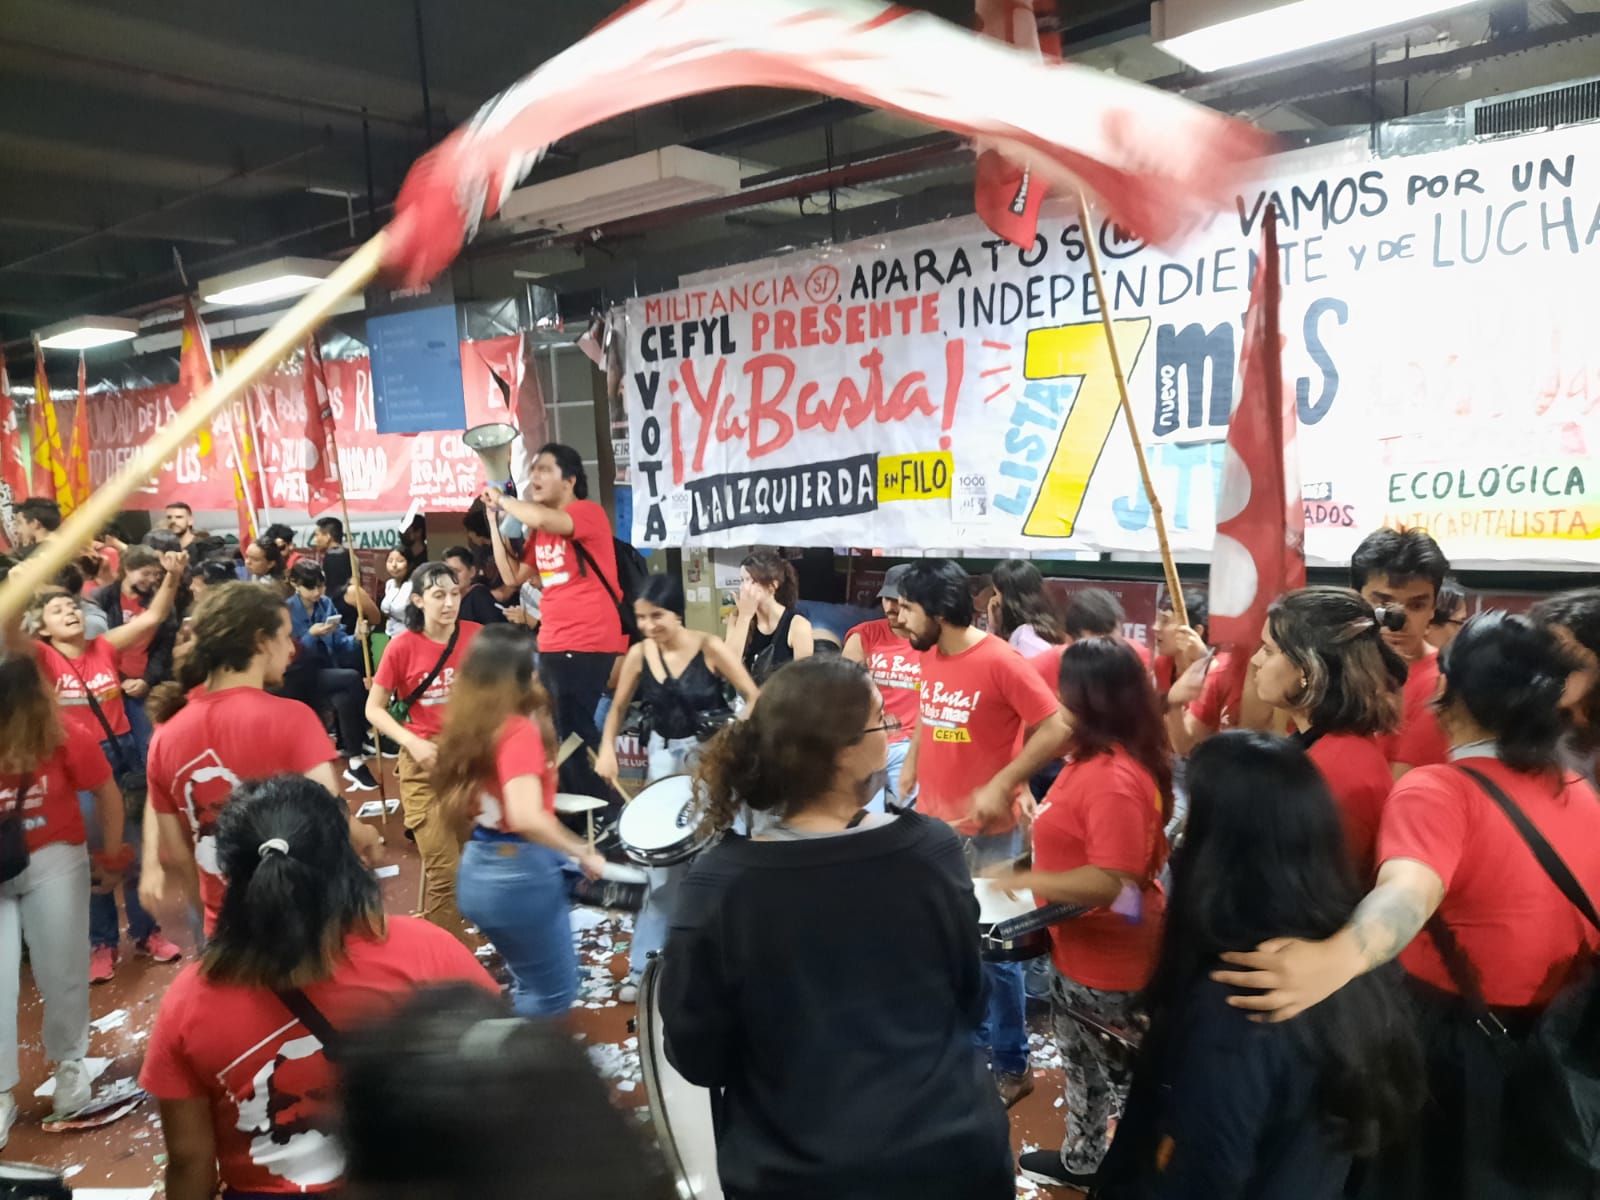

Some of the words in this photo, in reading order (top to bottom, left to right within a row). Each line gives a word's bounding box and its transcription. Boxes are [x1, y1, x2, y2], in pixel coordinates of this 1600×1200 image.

[645, 275, 799, 324] MILITANCIA
[850, 224, 1086, 300] APARATOS
[1235, 171, 1389, 236] VAMOS
[1407, 169, 1485, 206] POR
[1512, 154, 1575, 192] UN
[640, 315, 737, 363] CEFYL
[1377, 233, 1416, 262] DE
[1021, 316, 1152, 538] 7
[1159, 364, 1177, 427] nuevo
[899, 458, 948, 495] FILO
[992, 382, 1075, 516] LISTA
[1388, 464, 1586, 503] ECOLÓGICA
[935, 729, 966, 741] CEFYL
